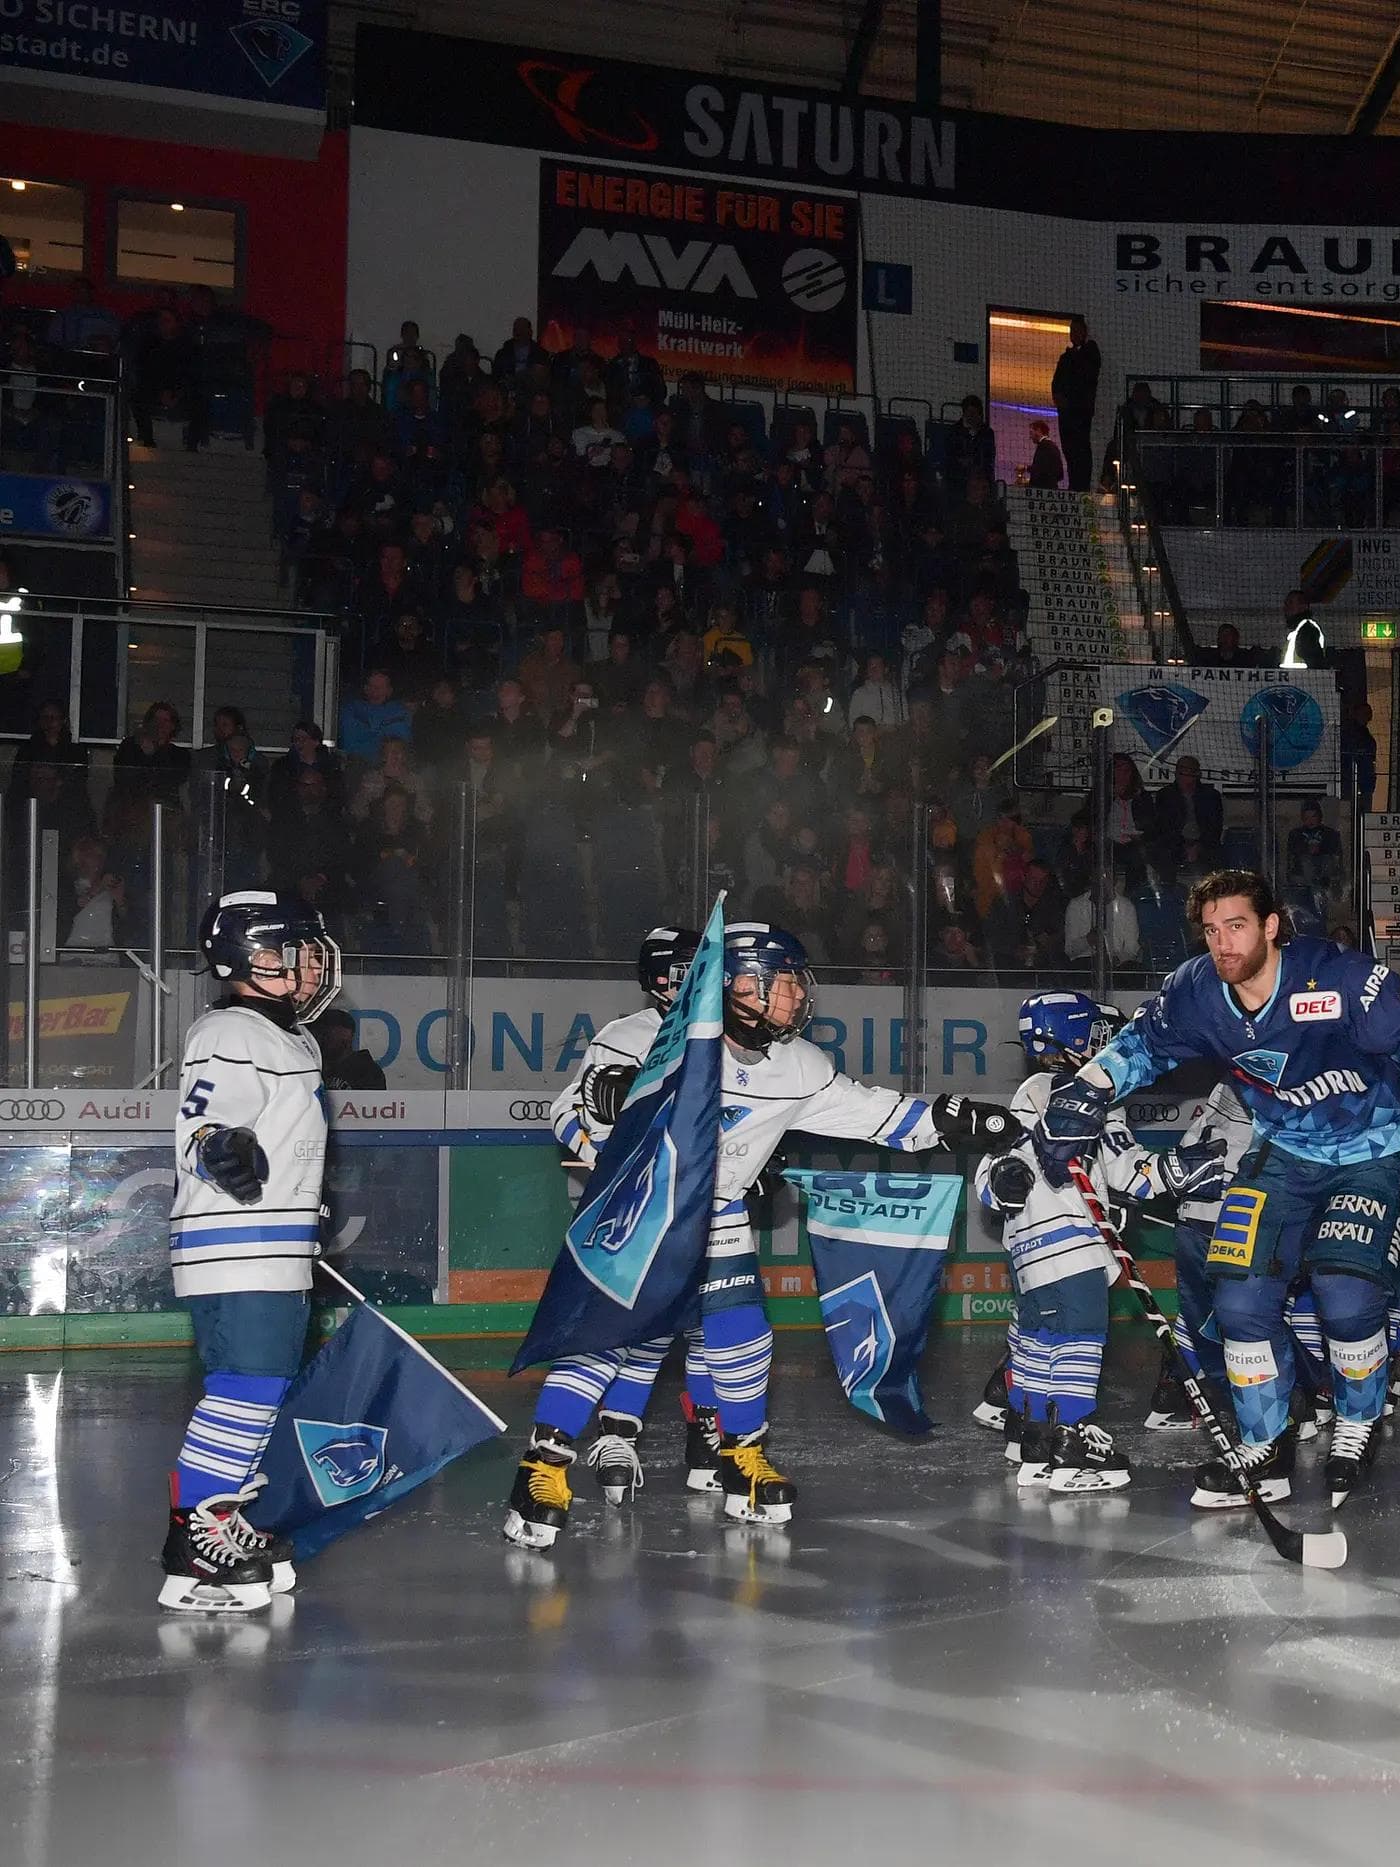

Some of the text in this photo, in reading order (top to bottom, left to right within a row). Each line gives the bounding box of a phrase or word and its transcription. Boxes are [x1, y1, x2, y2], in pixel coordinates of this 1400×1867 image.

[34, 1, 198, 46] SICHERN!
[683, 84, 956, 190] SATURN
[555, 166, 705, 224] ENERGIE
[790, 199, 848, 241] SIE
[551, 226, 759, 300] MVA
[876, 267, 895, 306] L
[1116, 273, 1229, 295] sicher
[657, 334, 745, 359] Kraftwerk
[1026, 488, 1077, 500] BRAUN
[1028, 501, 1079, 513] BRAUN
[1030, 514, 1081, 527] BRAUN
[1031, 527, 1083, 540] BRAUN
[1035, 540, 1088, 553] BRAUN
[1358, 539, 1391, 553] INVG
[1038, 554, 1091, 567] BRAUN
[1039, 569, 1092, 581] BRAUN
[1042, 582, 1096, 594] BRAUN
[1044, 596, 1099, 610] BRAUN
[1047, 611, 1102, 625] BRAUN
[1051, 625, 1106, 640] BRAUN
[1054, 641, 1110, 654] BRAUN
[1061, 671, 1100, 684] BRA
[1150, 670, 1163, 680] M
[1191, 669, 1290, 682] PANTHER
[1063, 688, 1097, 700] BRA
[1295, 996, 1336, 1016] DEL
[78, 1101, 152, 1120] Audi
[338, 1101, 406, 1120] Audi
[1317, 1221, 1375, 1246] BRÄU
